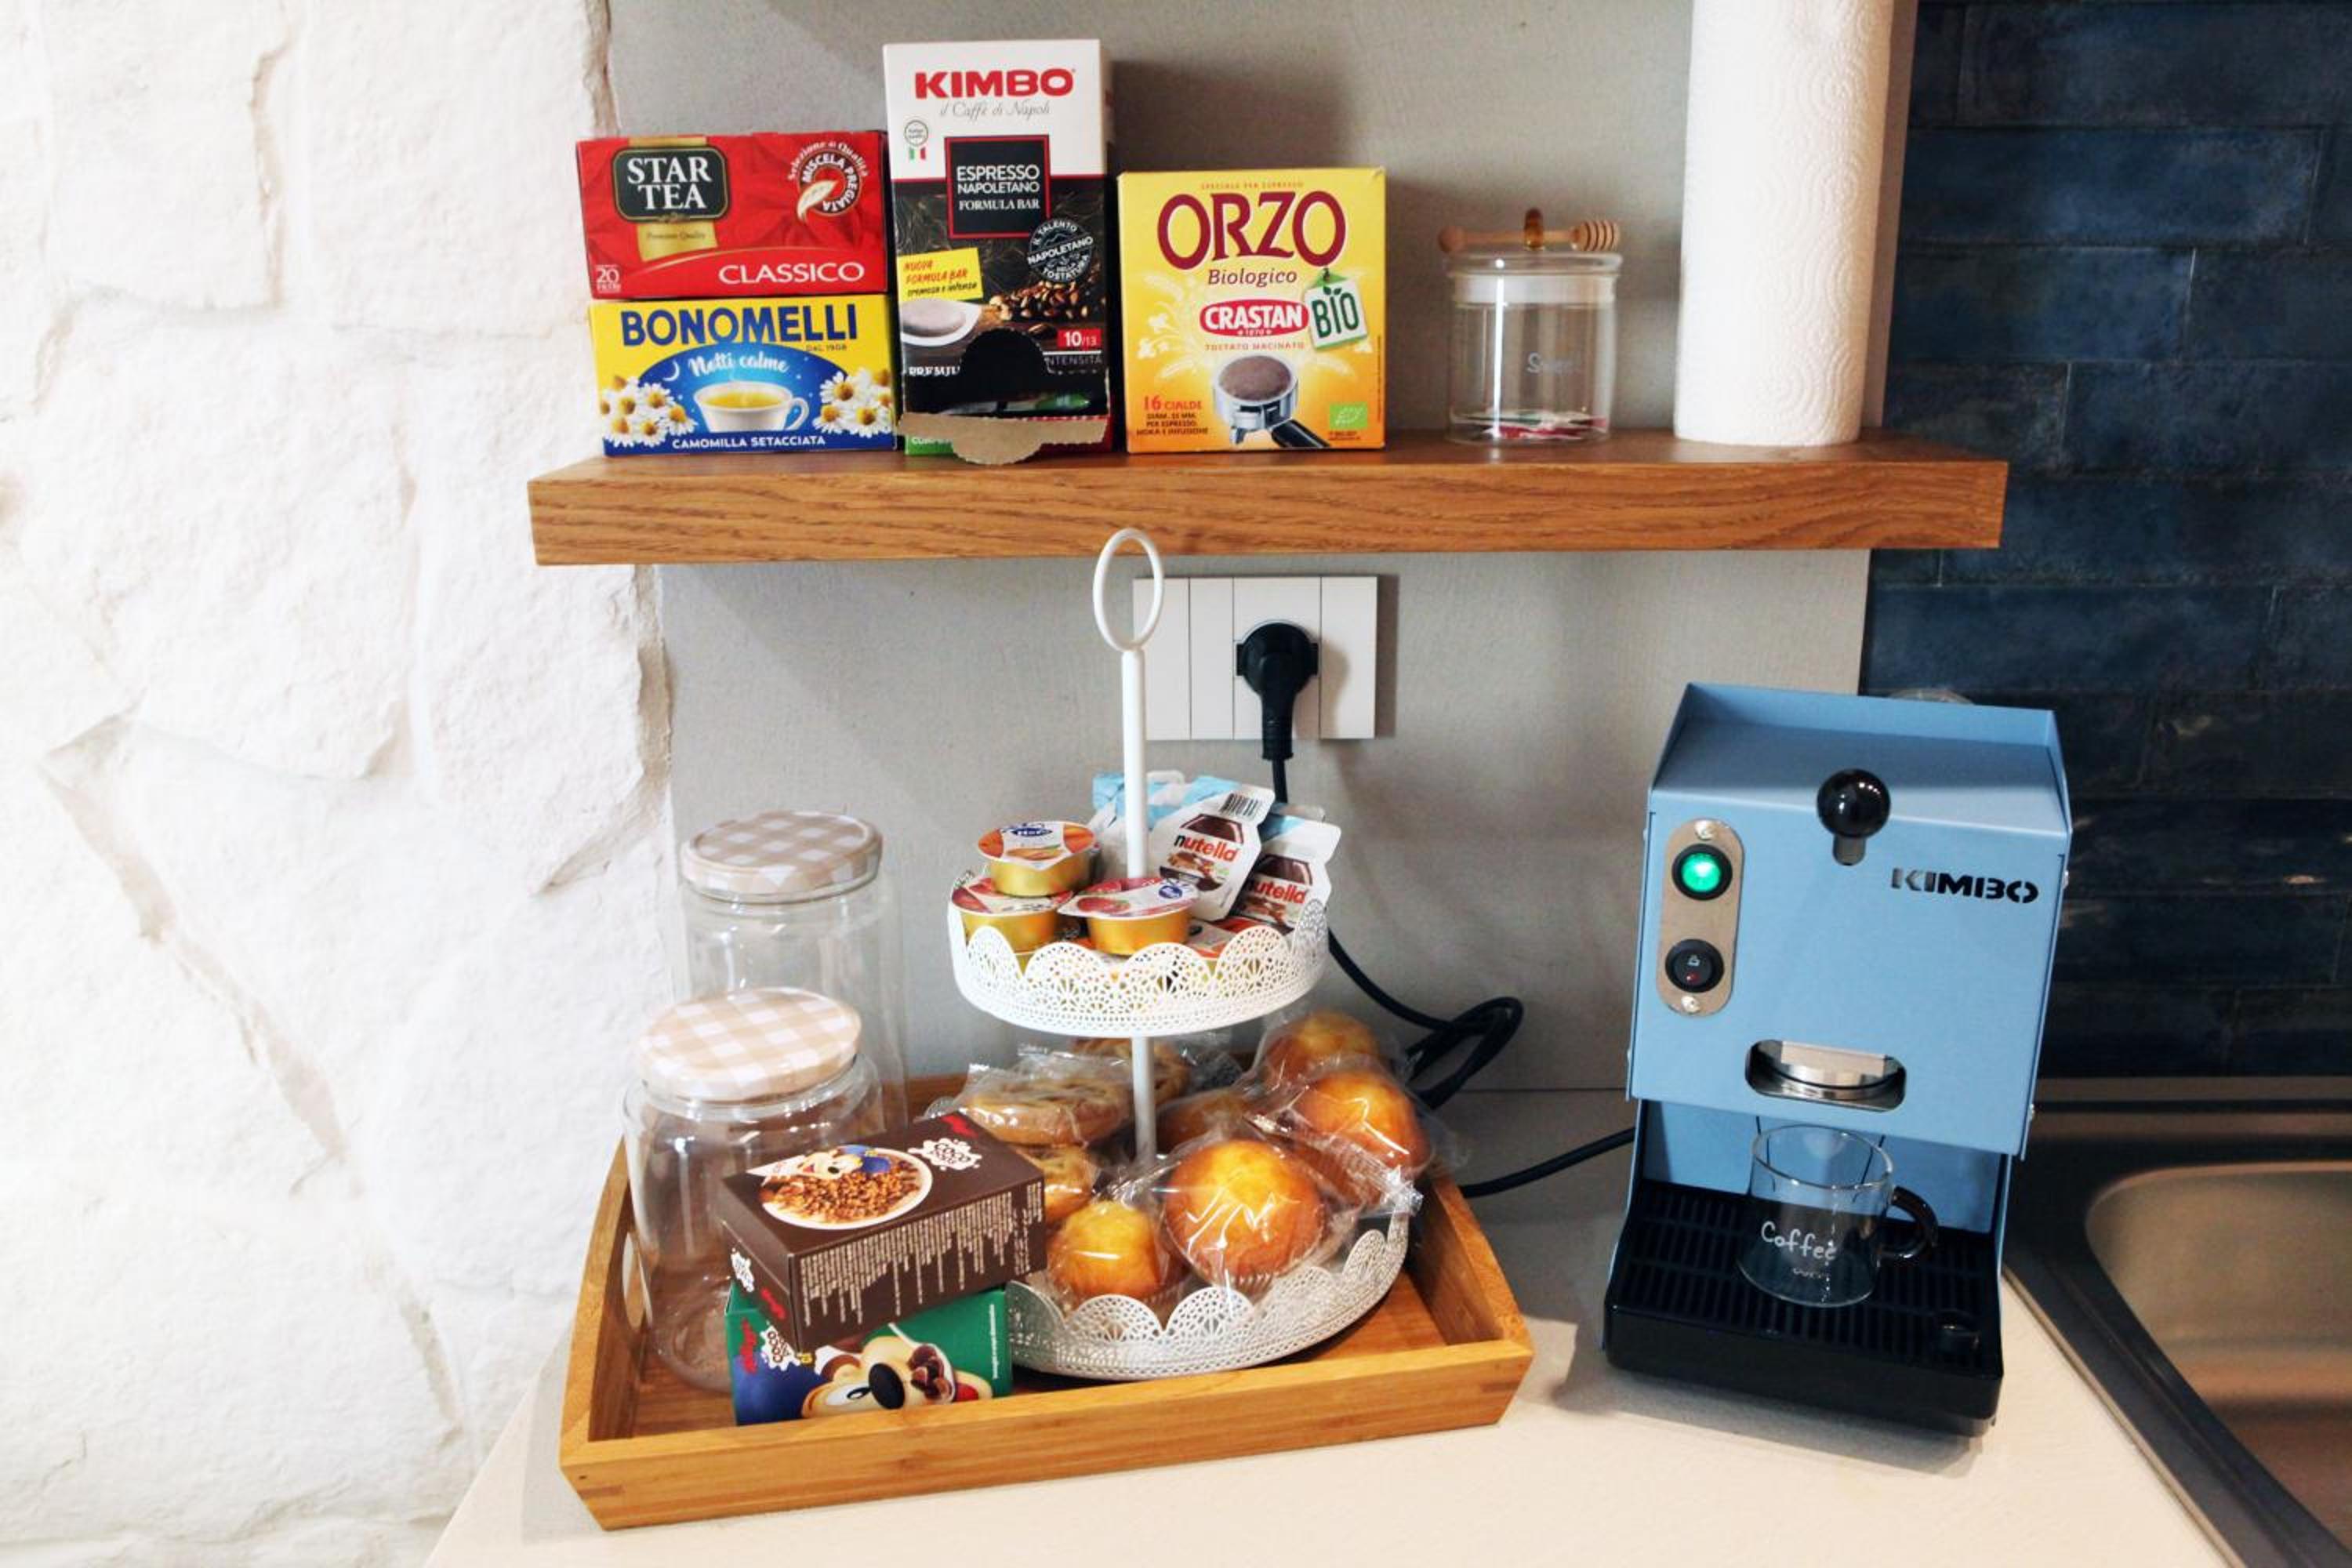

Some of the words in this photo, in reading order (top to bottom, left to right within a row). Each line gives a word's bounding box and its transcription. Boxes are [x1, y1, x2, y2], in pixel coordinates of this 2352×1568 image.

[914, 68, 1073, 99] KIMBO
[1007, 100, 1051, 119] Napoli
[627, 156, 712, 183] STAR
[802, 154, 845, 183] MISCELA
[956, 165, 1040, 181] ESPRESSO
[637, 183, 707, 209] TEA
[823, 166, 858, 212] PREGIATA
[957, 181, 1040, 194] NAPOLETANO
[959, 199, 1015, 211] FORMULA
[1017, 198, 1040, 210] BAR
[1157, 191, 1345, 270] ORZO
[1027, 236, 1093, 264] NAPOLETANO
[597, 268, 619, 283] 20
[718, 263, 865, 285] CLASSICO
[1208, 267, 1298, 288] Biologico
[620, 303, 857, 347] BONOMELLI
[1204, 305, 1302, 329] CRASTAN
[688, 352, 735, 376] Notti
[739, 351, 789, 373] calme
[1145, 395, 1161, 410] 16
[1164, 401, 1201, 409] CIALDE
[672, 437, 747, 449] CAMOMILLA
[750, 435, 826, 448] SETACCIATA
[1174, 834, 1239, 862] nutella
[1890, 866, 2038, 904] KIMBO
[1761, 1221, 1836, 1261] Coffee
